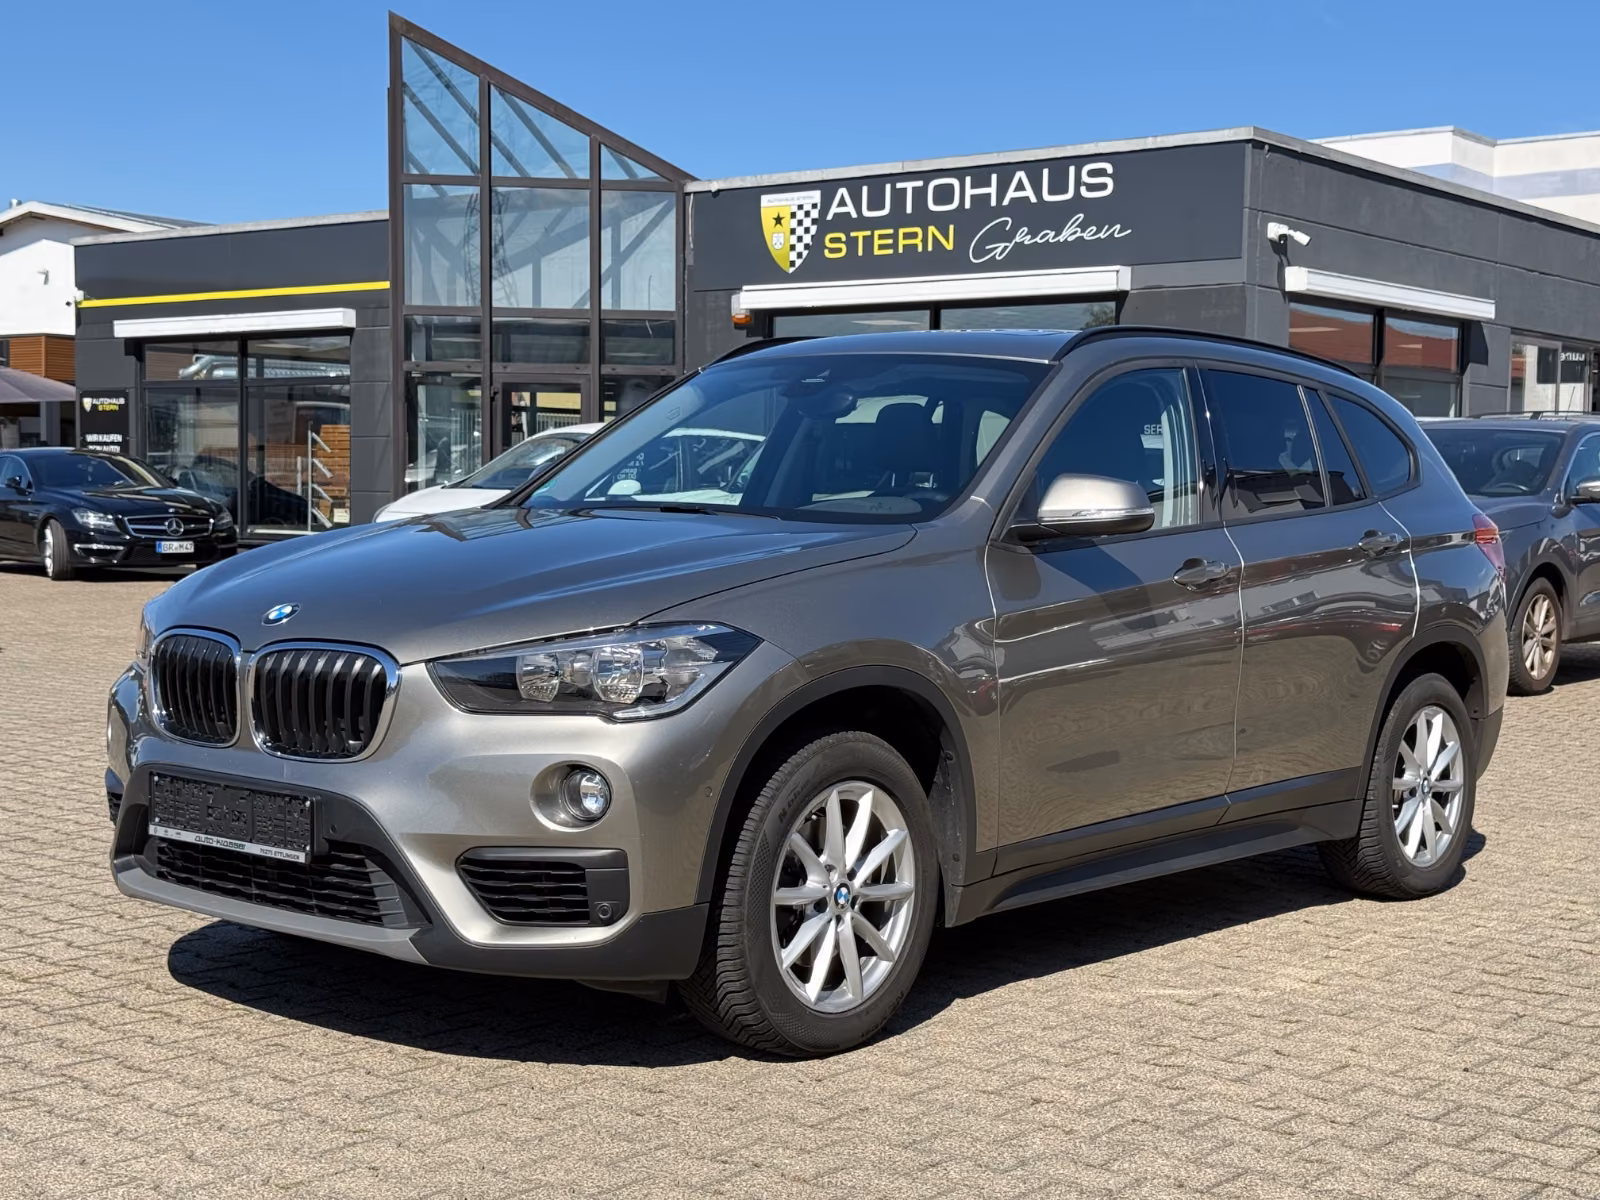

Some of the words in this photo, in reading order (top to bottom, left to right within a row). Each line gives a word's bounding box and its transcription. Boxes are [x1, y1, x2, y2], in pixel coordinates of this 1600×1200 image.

[826, 162, 1114, 220] AUTOHAUS
[824, 224, 954, 258] STERN
[969, 213, 1132, 263] Graben
[92, 397, 125, 405] AUTOHAUS
[86, 433, 98, 443] WIR
[98, 433, 122, 443] KAUFEN
